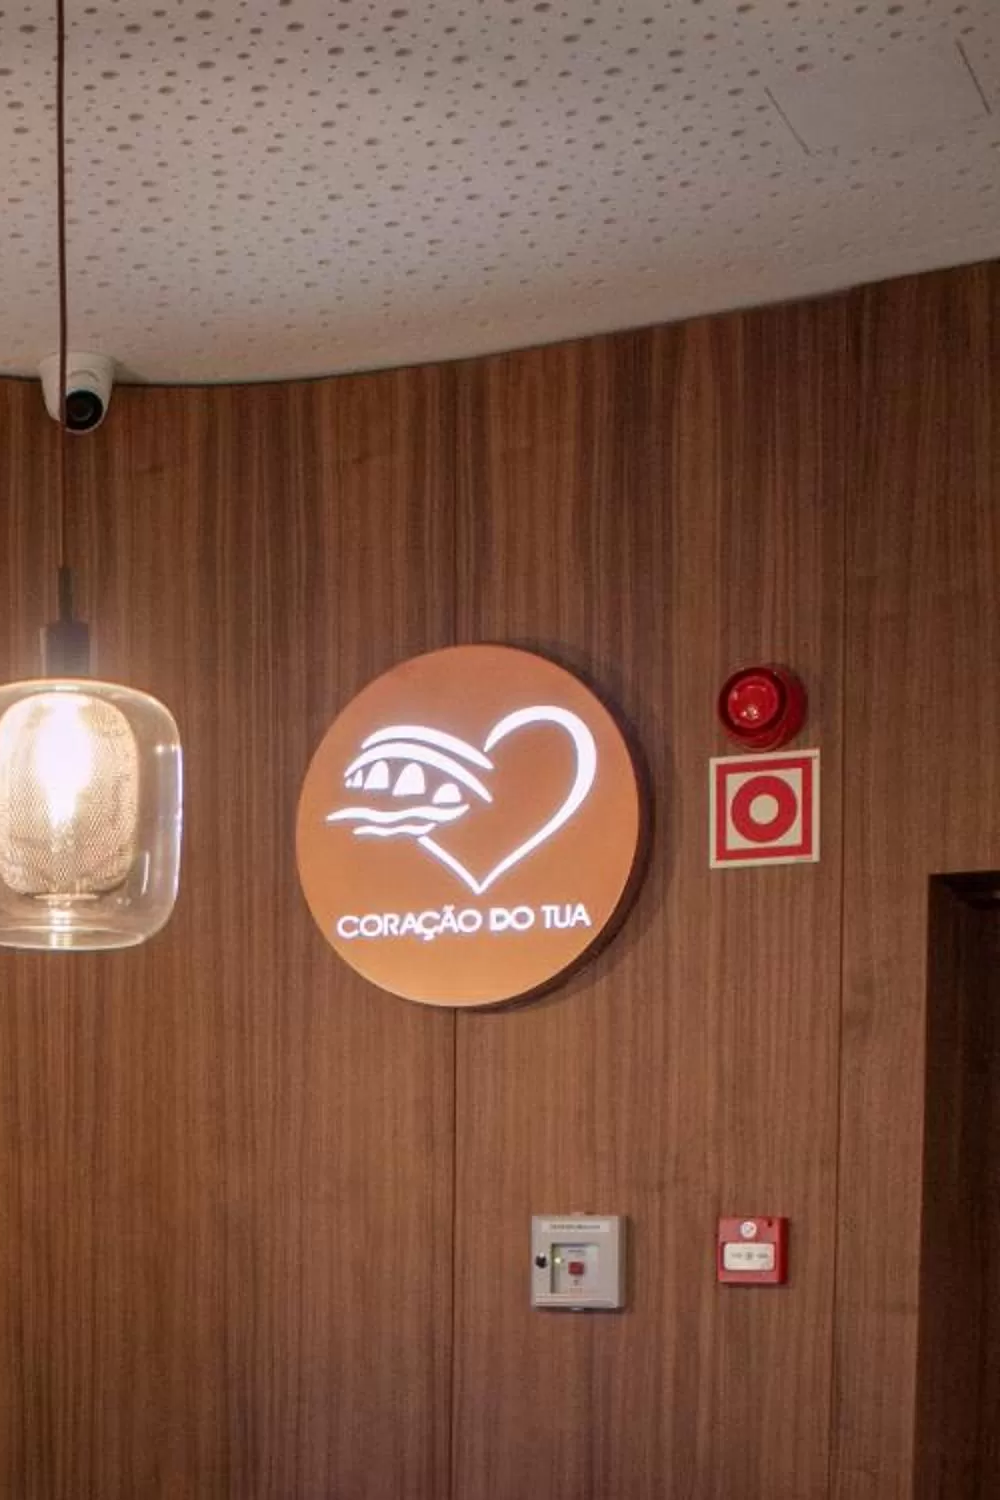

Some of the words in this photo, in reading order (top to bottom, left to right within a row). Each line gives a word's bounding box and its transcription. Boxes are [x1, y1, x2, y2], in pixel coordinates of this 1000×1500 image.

[336, 905, 483, 941] CORAÇÃO
[489, 906, 535, 931] DO
[541, 903, 592, 928] TUA
